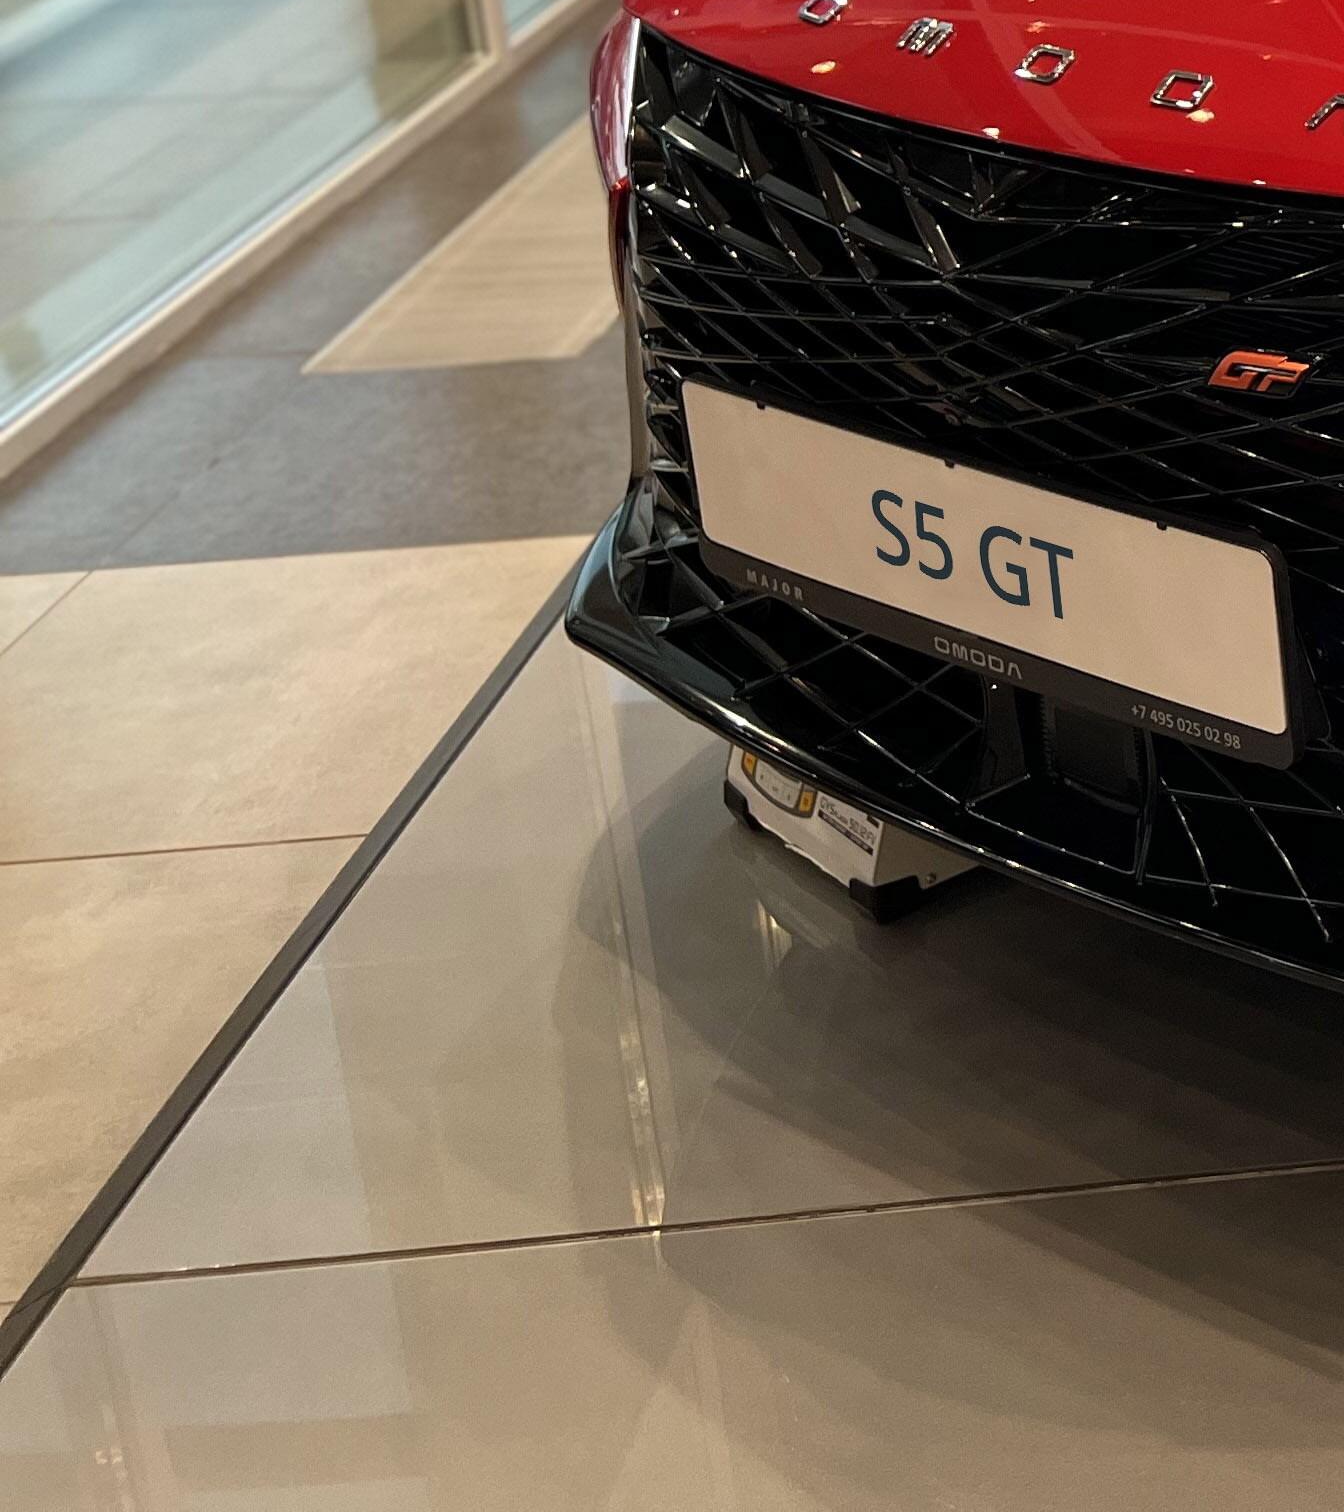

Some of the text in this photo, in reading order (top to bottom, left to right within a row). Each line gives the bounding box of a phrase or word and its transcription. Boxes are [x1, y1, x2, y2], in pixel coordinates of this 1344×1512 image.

[1208, 350, 1310, 392] GT
[871, 489, 1074, 620] S5 GT
[746, 568, 804, 601] MAJOR
[933, 635, 1023, 680] OMODA
[1130, 704, 1241, 749] +7 495 025 02 98
